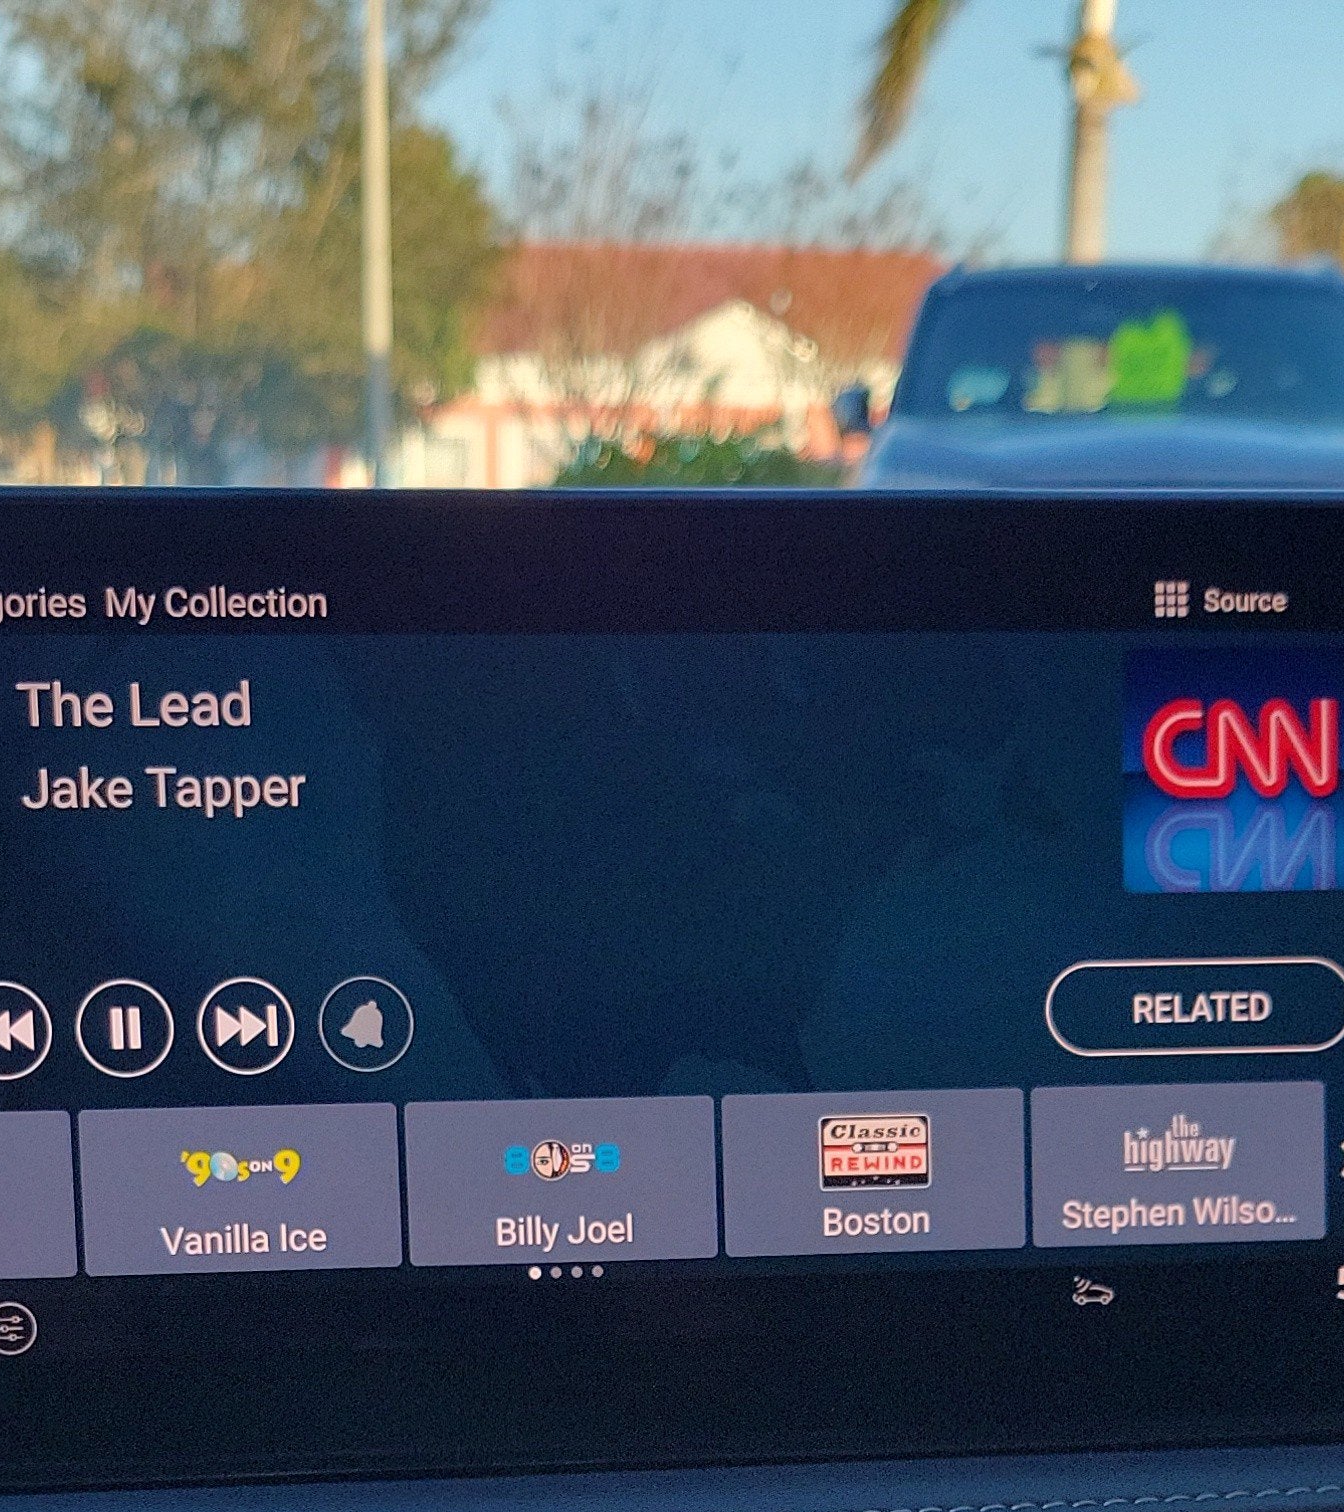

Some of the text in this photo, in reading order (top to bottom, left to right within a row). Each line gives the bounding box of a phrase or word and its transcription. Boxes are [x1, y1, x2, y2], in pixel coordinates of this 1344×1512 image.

[106, 586, 327, 625] My Collection
[1204, 588, 1288, 612] Source
[15, 680, 250, 727] The Lead
[1143, 698, 1339, 798] CNN
[22, 766, 305, 818] Jake Tapper
[1134, 992, 1272, 1023] RELATED
[830, 1123, 922, 1140] Classic
[1123, 1127, 1236, 1172] highway
[830, 1155, 923, 1172] REWIND
[497, 1213, 632, 1252] Billy Joel
[824, 1208, 929, 1236] Boston
[1063, 1198, 1184, 1234] Stephen
[160, 1224, 326, 1255] Vanilla Ice
